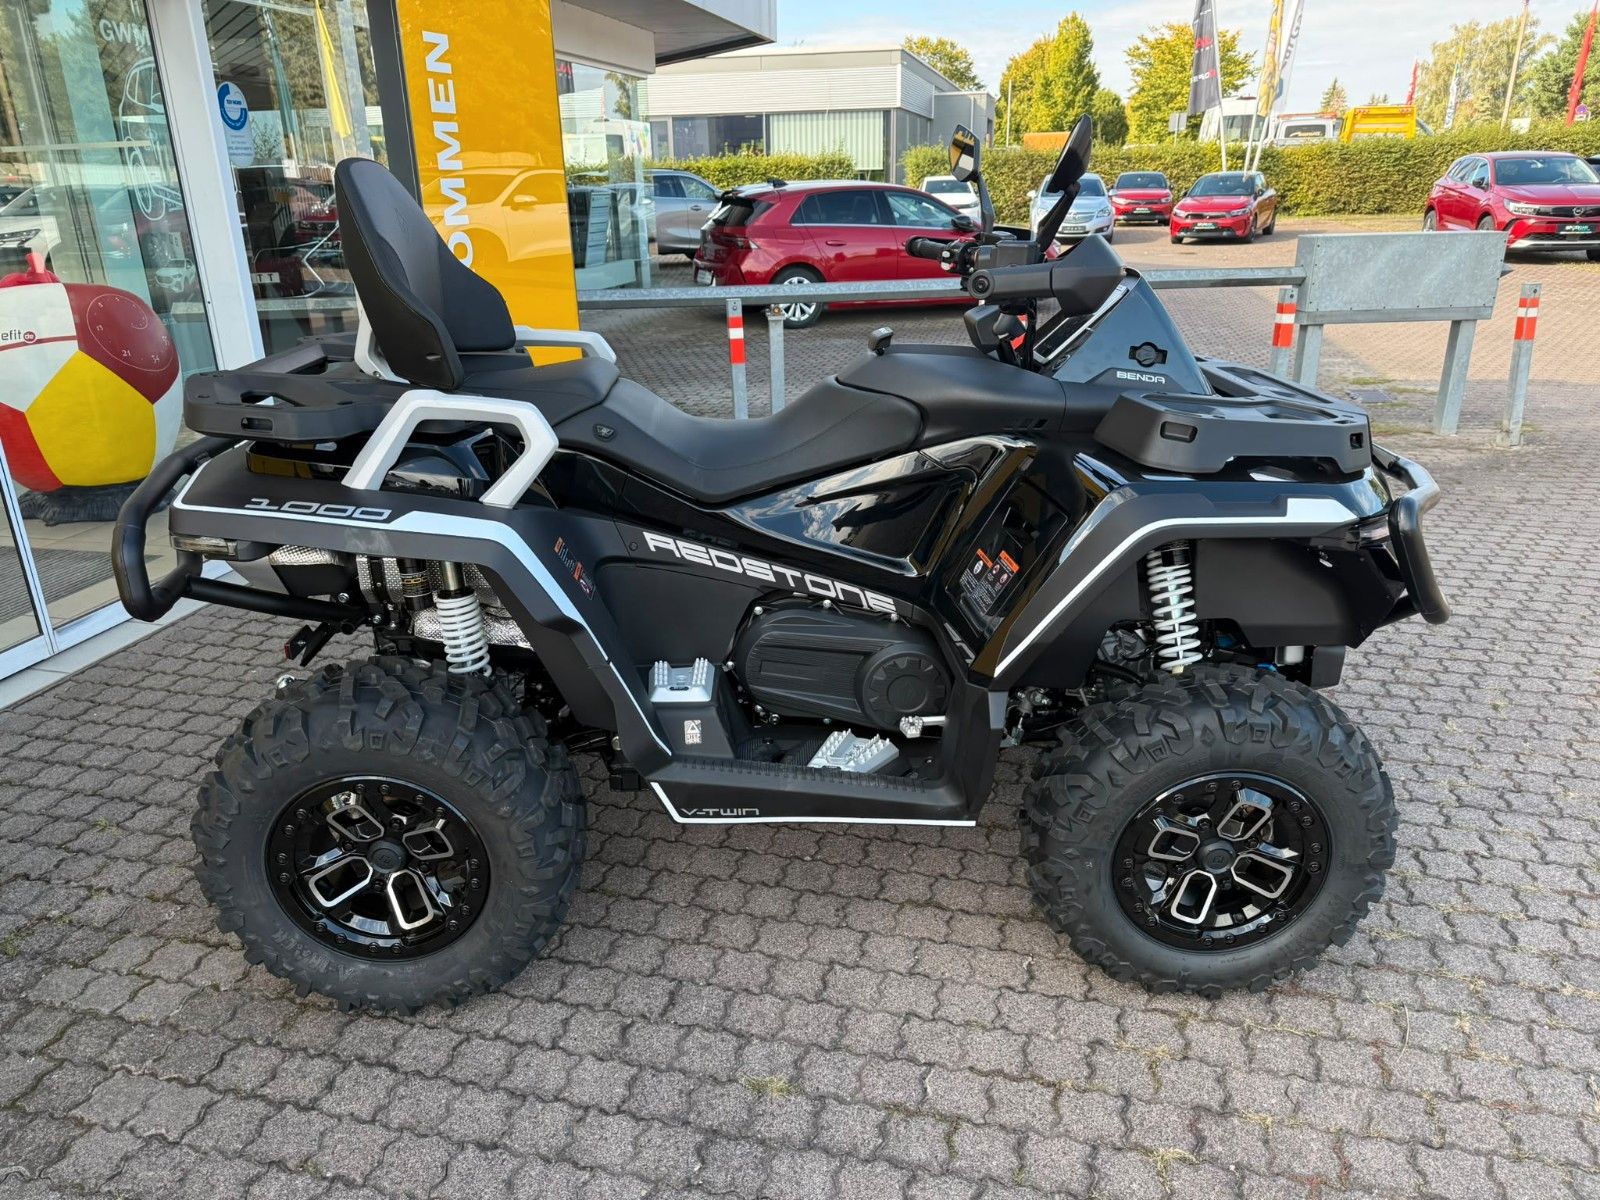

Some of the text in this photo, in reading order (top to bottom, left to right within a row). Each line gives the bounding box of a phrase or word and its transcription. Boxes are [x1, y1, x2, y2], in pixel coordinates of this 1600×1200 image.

[1116, 370, 1166, 384] BENDA
[244, 498, 392, 521] 1000
[642, 531, 898, 613] REDSTONE
[680, 807, 759, 816] V-TWIN
